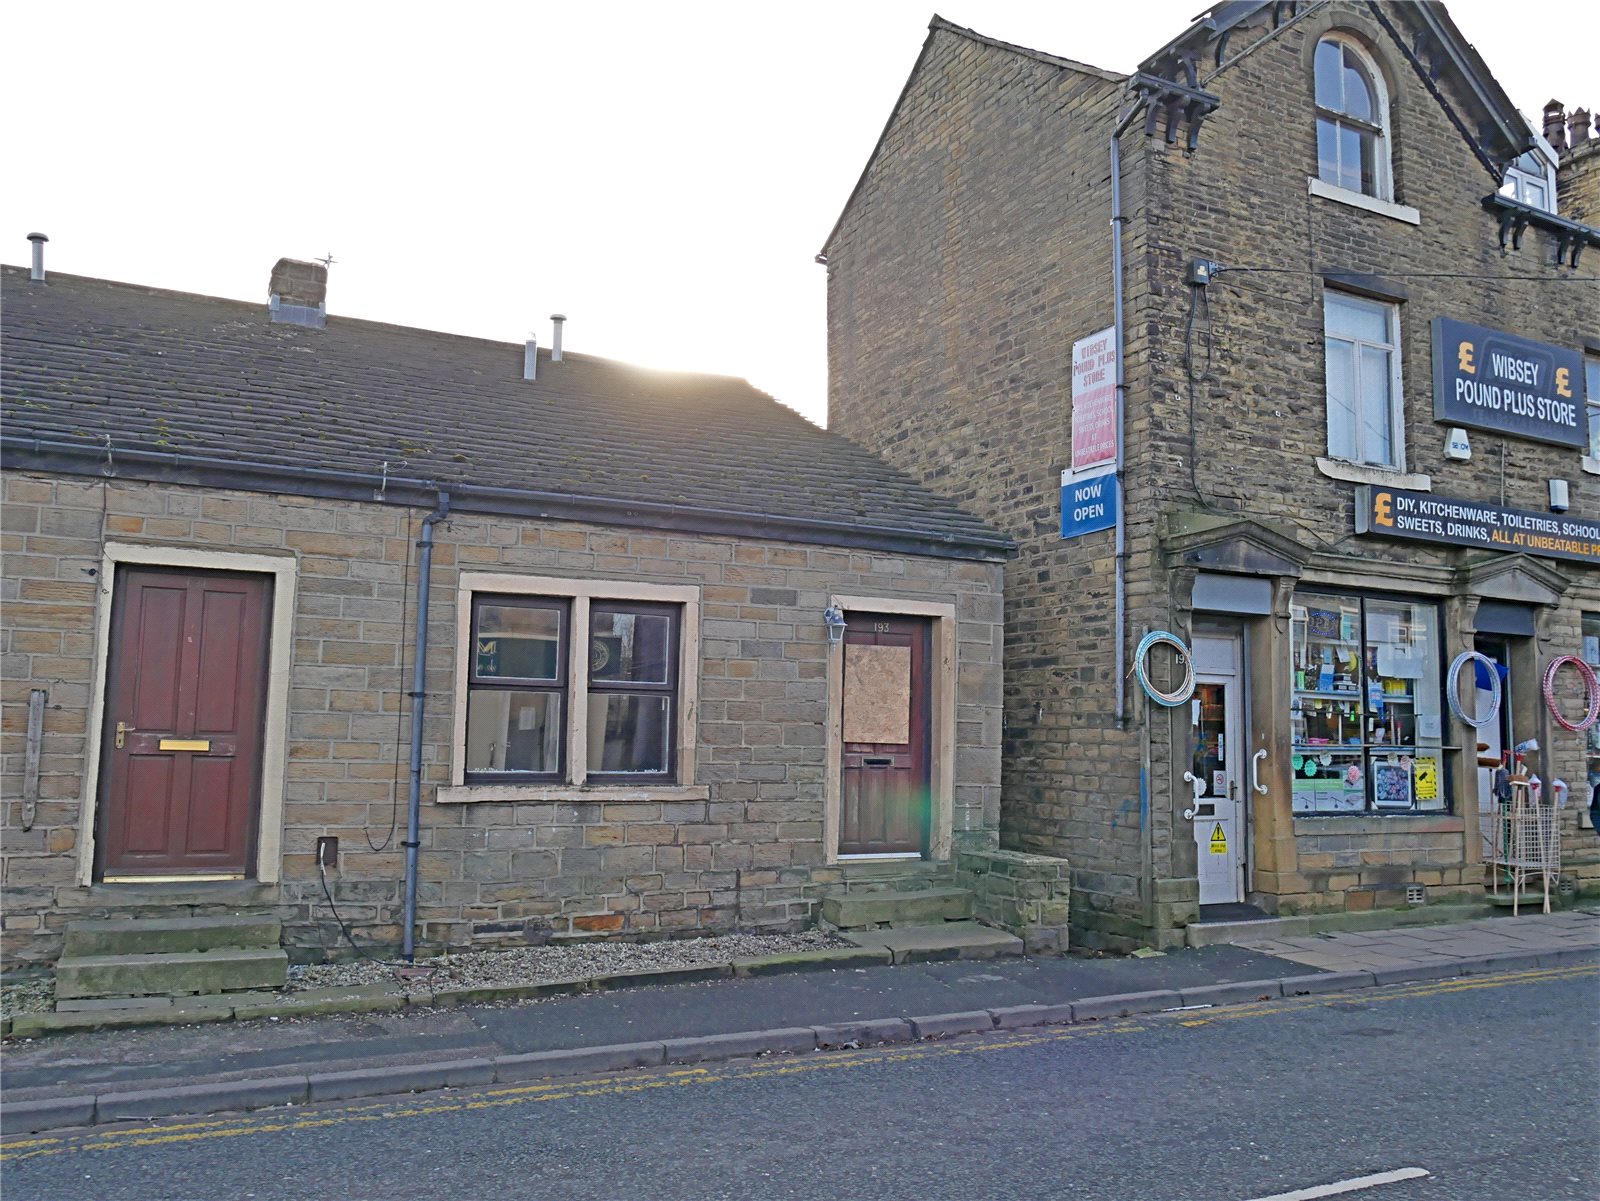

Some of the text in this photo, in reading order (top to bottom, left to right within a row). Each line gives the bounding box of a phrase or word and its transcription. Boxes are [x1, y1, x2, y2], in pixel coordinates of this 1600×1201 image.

[1073, 350, 1116, 376] POUND PLUS
[1081, 338, 1108, 358] WIBSEY
[1458, 341, 1476, 374] £
[1083, 368, 1105, 387] STORE
[1492, 353, 1539, 386] WIBSEY
[1555, 367, 1572, 398] £
[1456, 378, 1501, 409] POUND
[1504, 389, 1535, 417] PLUS
[1537, 397, 1577, 427] STORE
[1074, 484, 1102, 502] NOW
[1073, 503, 1104, 522] OPEN
[1374, 492, 1394, 527] £
[1396, 497, 1600, 540] DIY, KITCHENWARE, TOILETRIES, SCHOOL
[1397, 515, 1445, 537] SWEETS,
[1447, 522, 1490, 543] DRINKS,
[1491, 529, 1512, 544] ALL
[1512, 532, 1525, 546] AT
[1527, 535, 1590, 555] UNBEATABLE
[873, 622, 890, 633] 193
